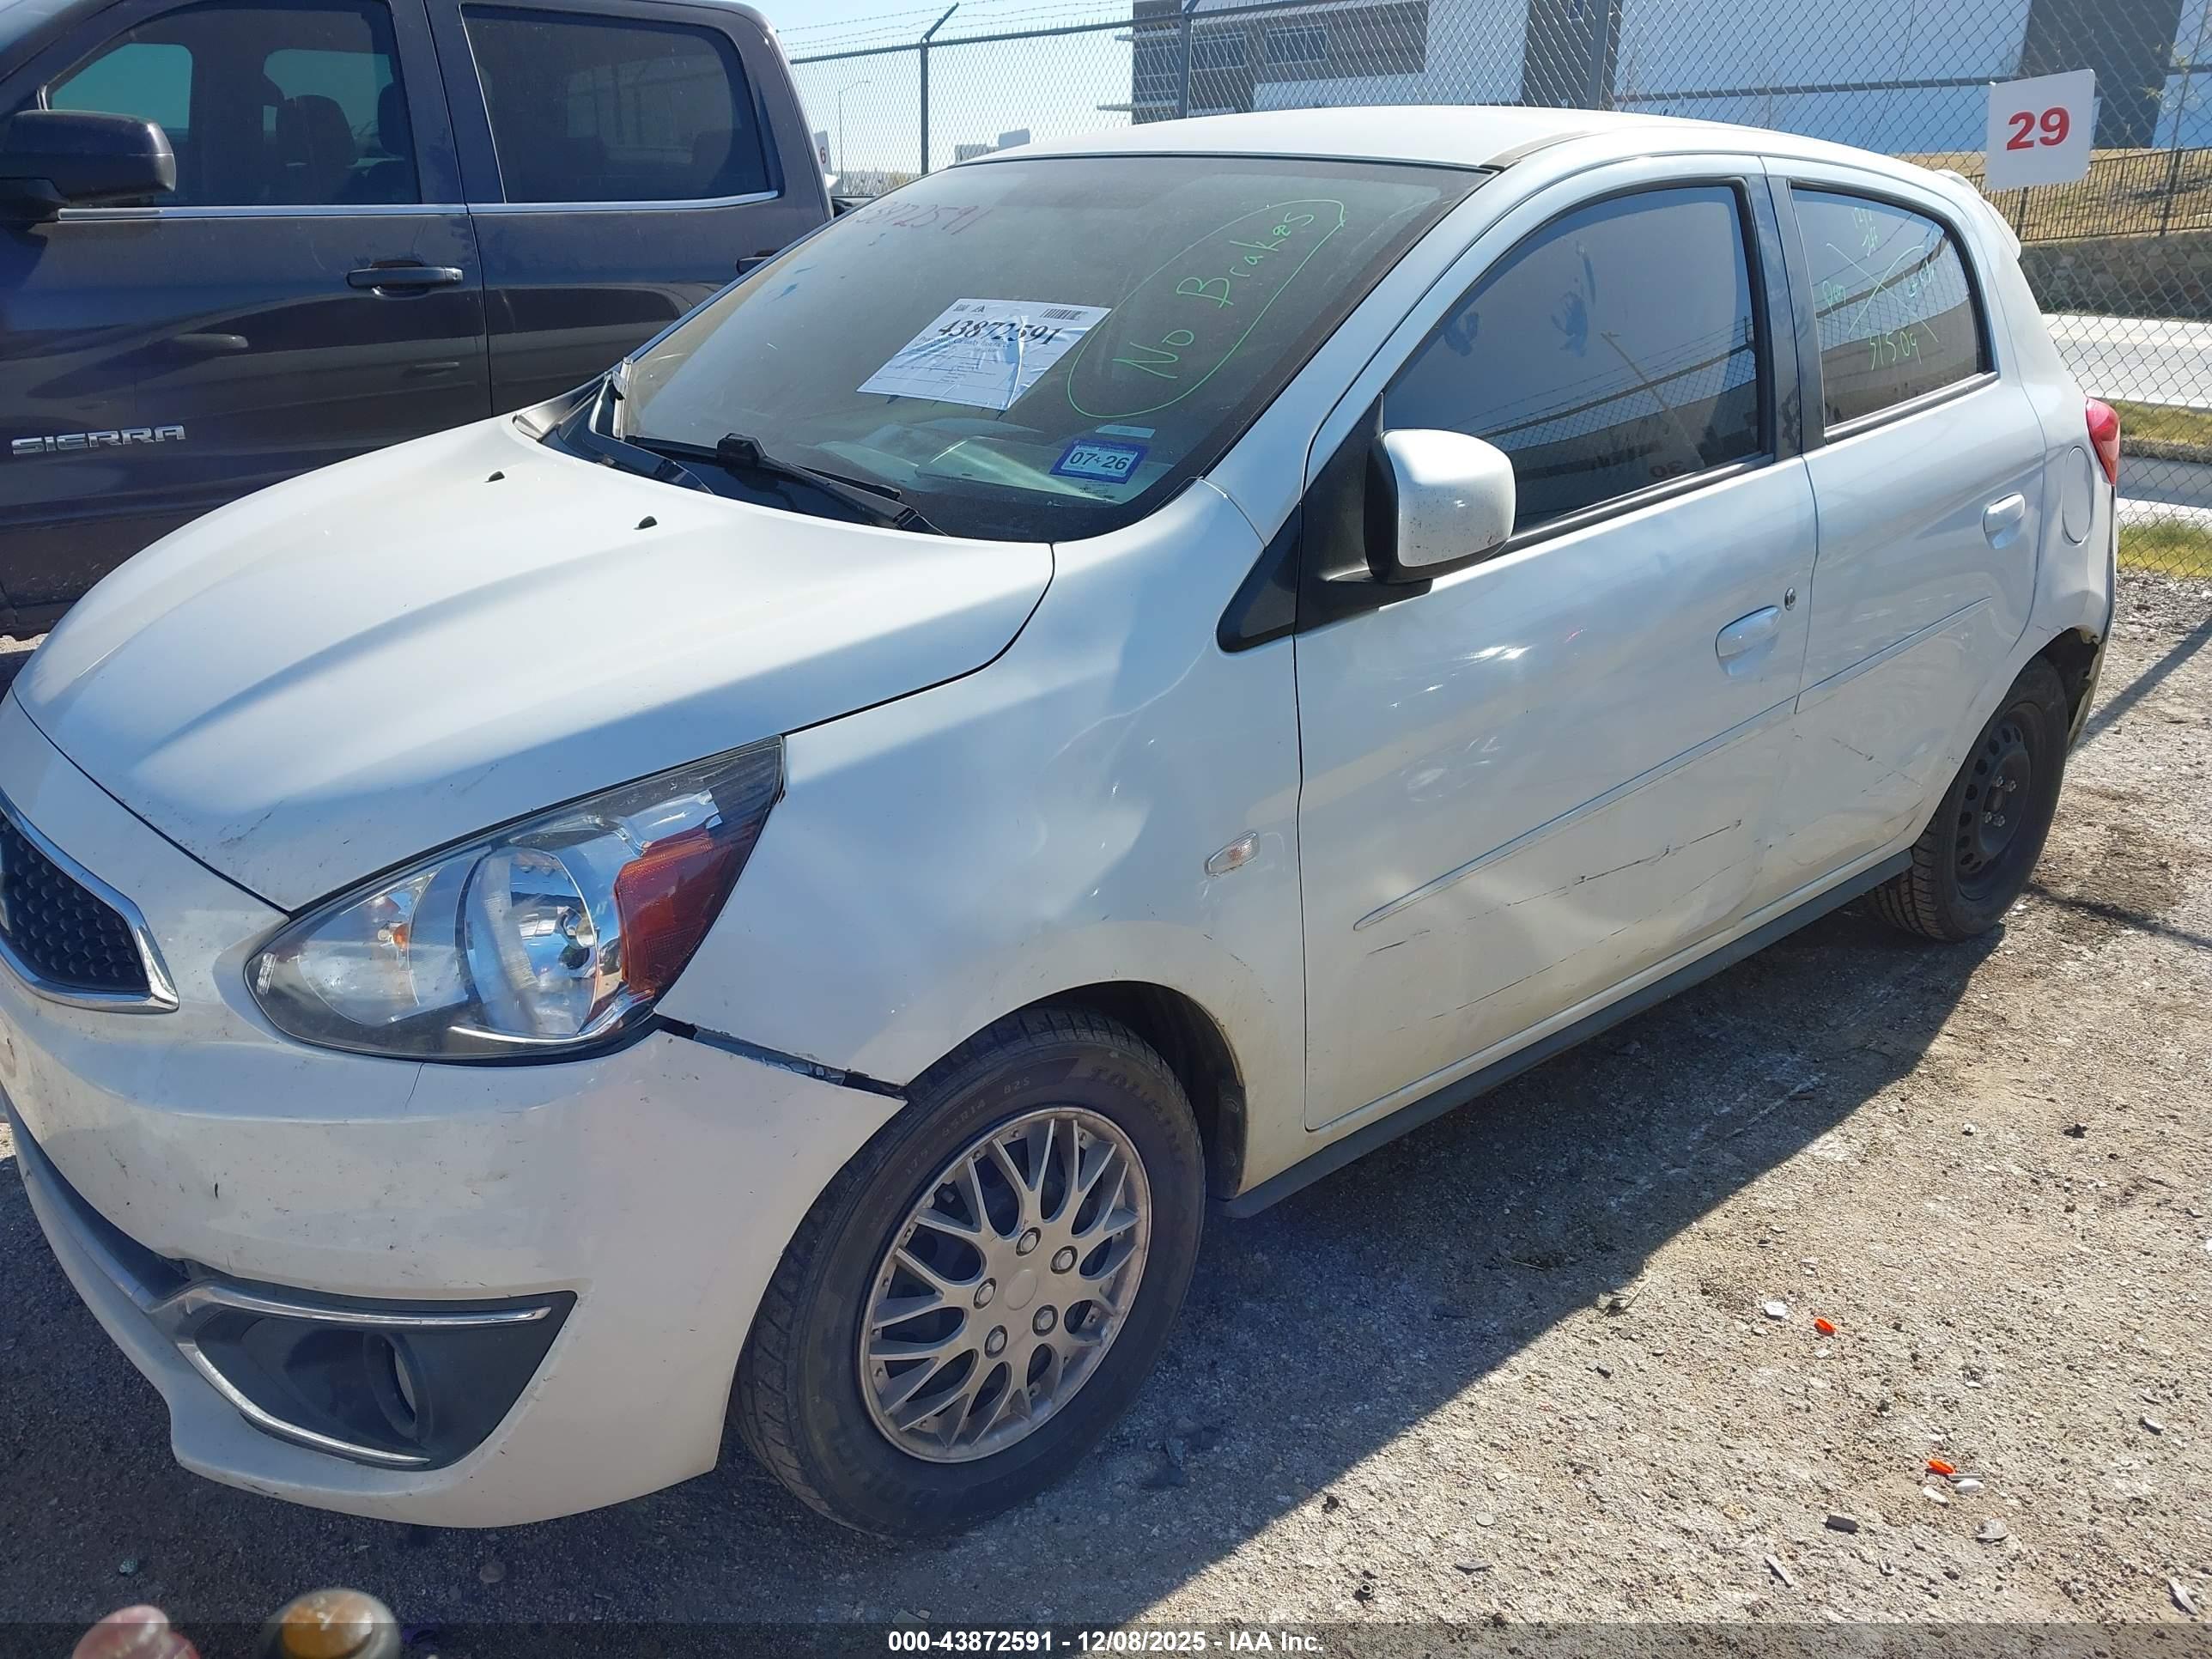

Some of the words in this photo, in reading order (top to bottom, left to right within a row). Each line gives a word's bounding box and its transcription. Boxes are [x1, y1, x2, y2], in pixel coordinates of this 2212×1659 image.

[2006, 106, 2070, 151] 29
[1112, 330, 1194, 379] No
[1176, 212, 1315, 308] Brakes
[938, 319, 1064, 345] 43872591
[11, 424, 186, 455] SIERRA
[1069, 452, 1098, 465] 07
[1100, 455, 1130, 471] 26
